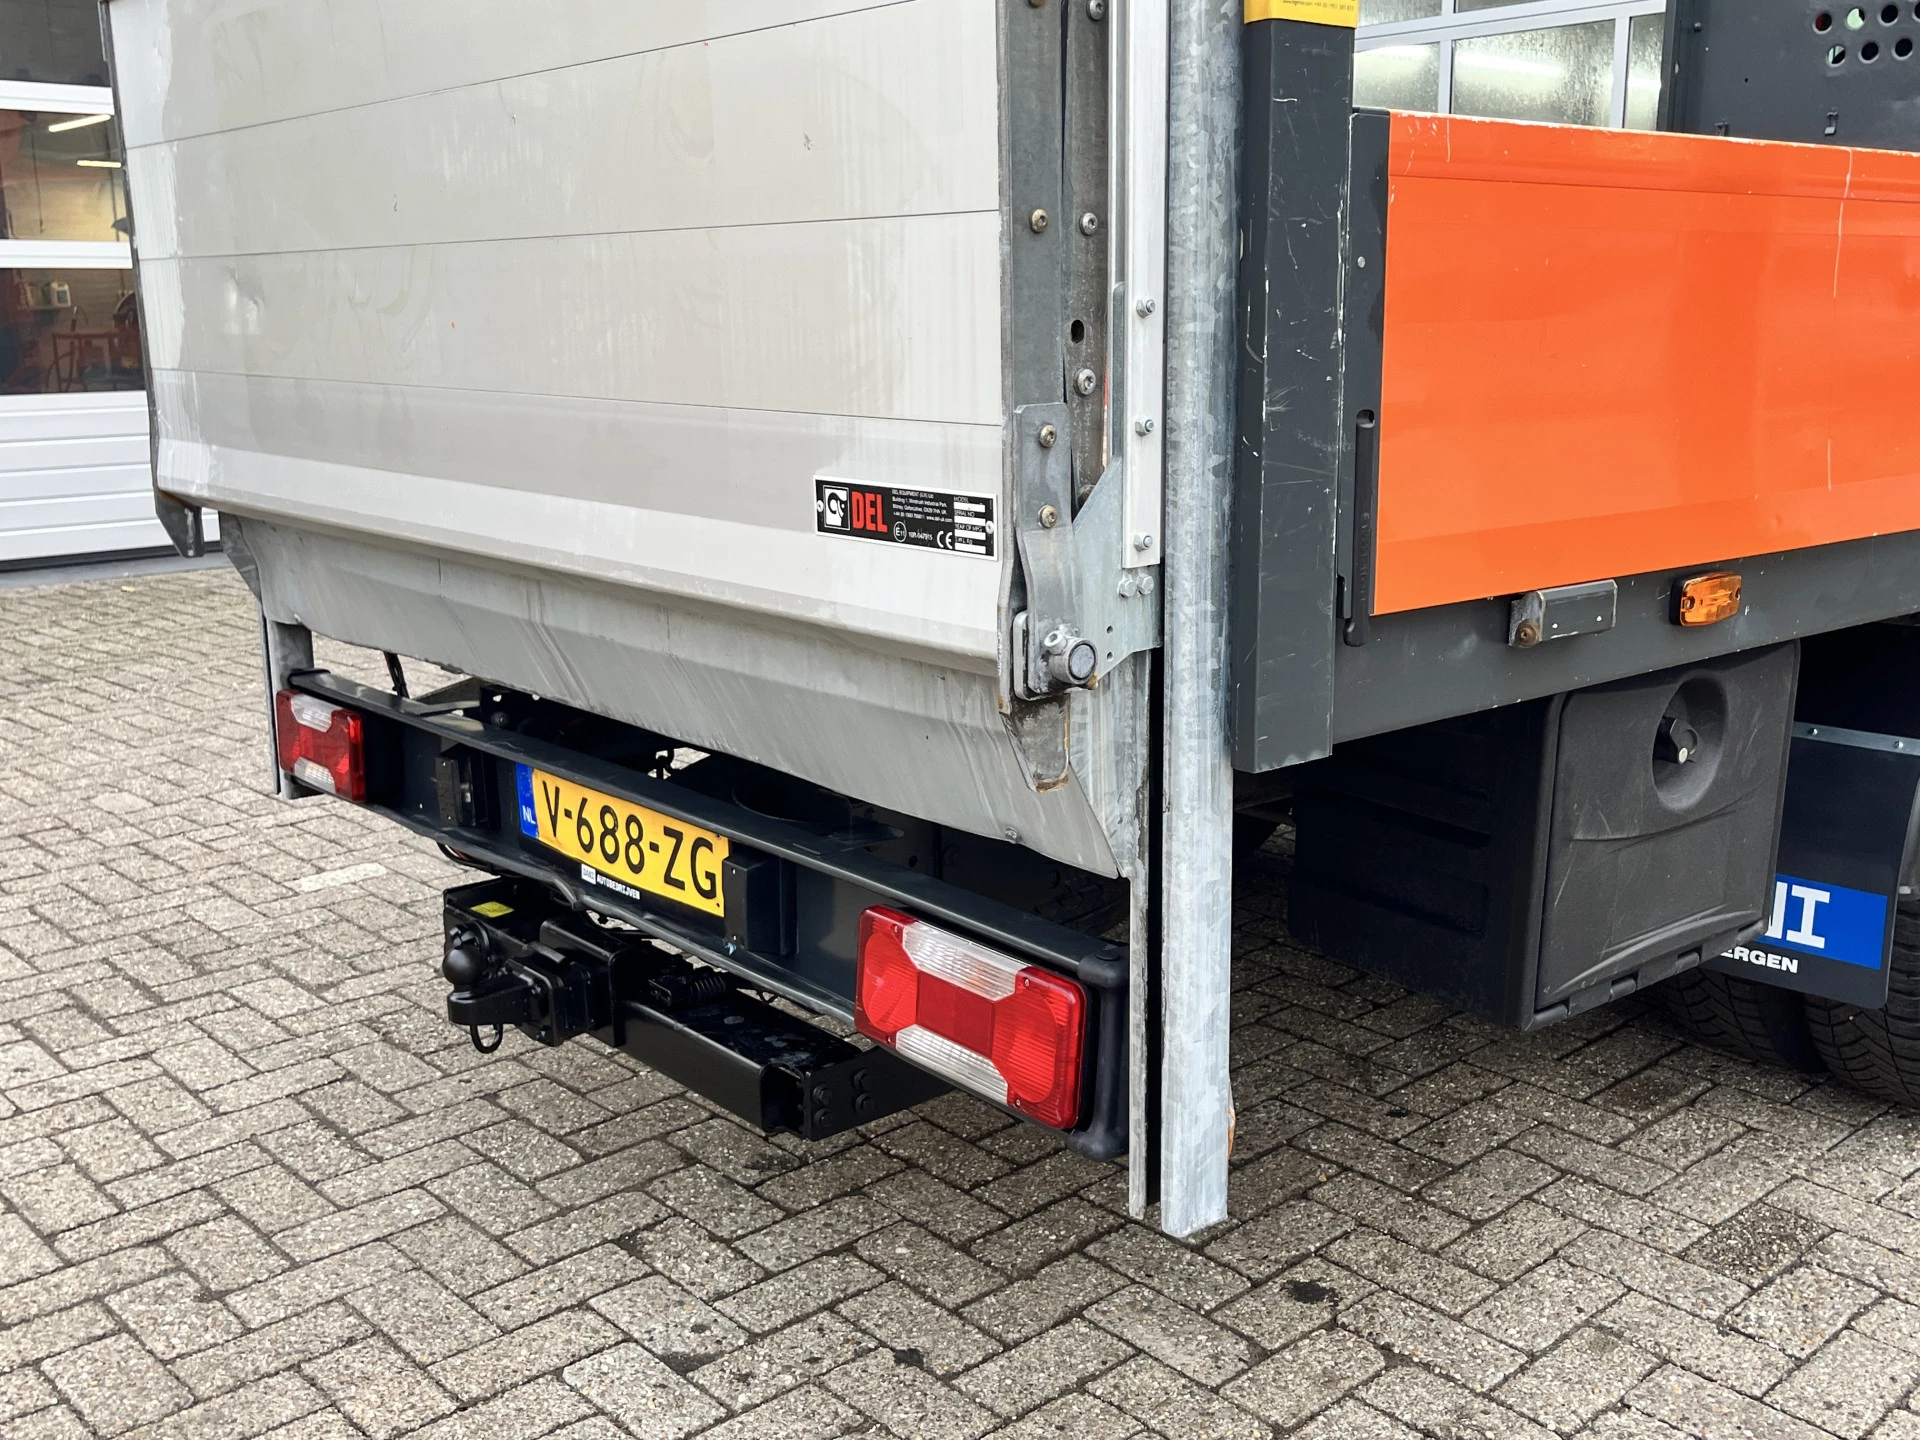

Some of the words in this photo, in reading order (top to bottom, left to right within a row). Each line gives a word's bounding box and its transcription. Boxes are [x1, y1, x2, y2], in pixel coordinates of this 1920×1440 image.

[851, 491, 888, 533] DEL
[522, 805, 536, 825] NL
[542, 780, 717, 900] V-688-ZG
[596, 873, 641, 901] AUTOBEDRIJVEN
